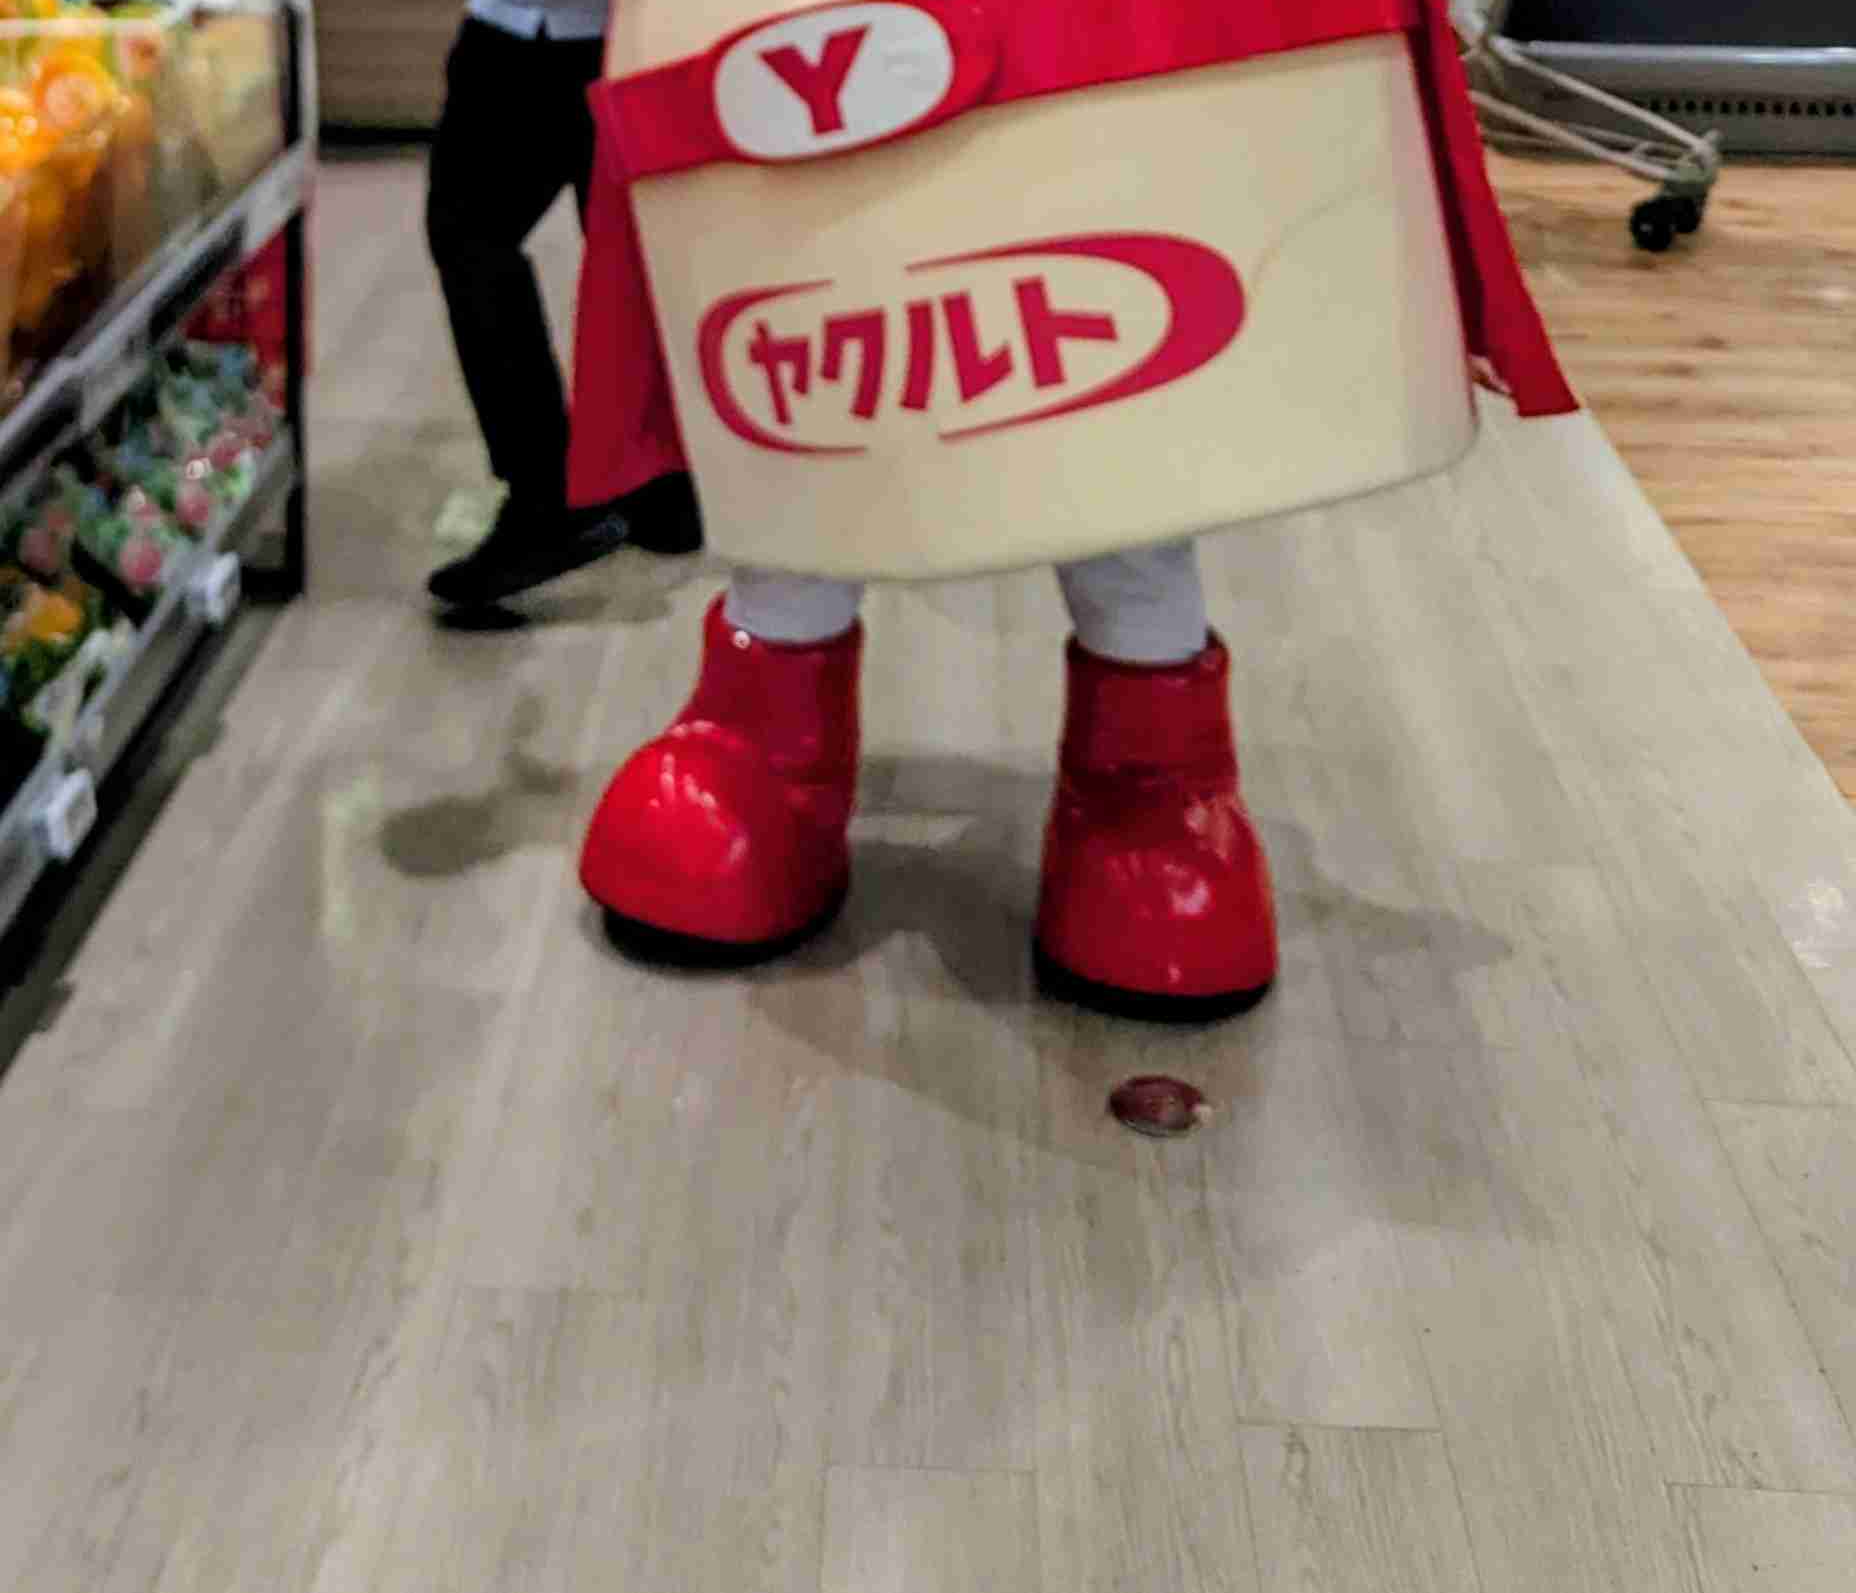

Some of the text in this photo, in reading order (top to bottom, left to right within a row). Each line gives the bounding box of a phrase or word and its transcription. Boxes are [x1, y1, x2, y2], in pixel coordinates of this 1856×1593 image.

[757, 24, 870, 136] Y
[747, 276, 1120, 426] ヤクルト
